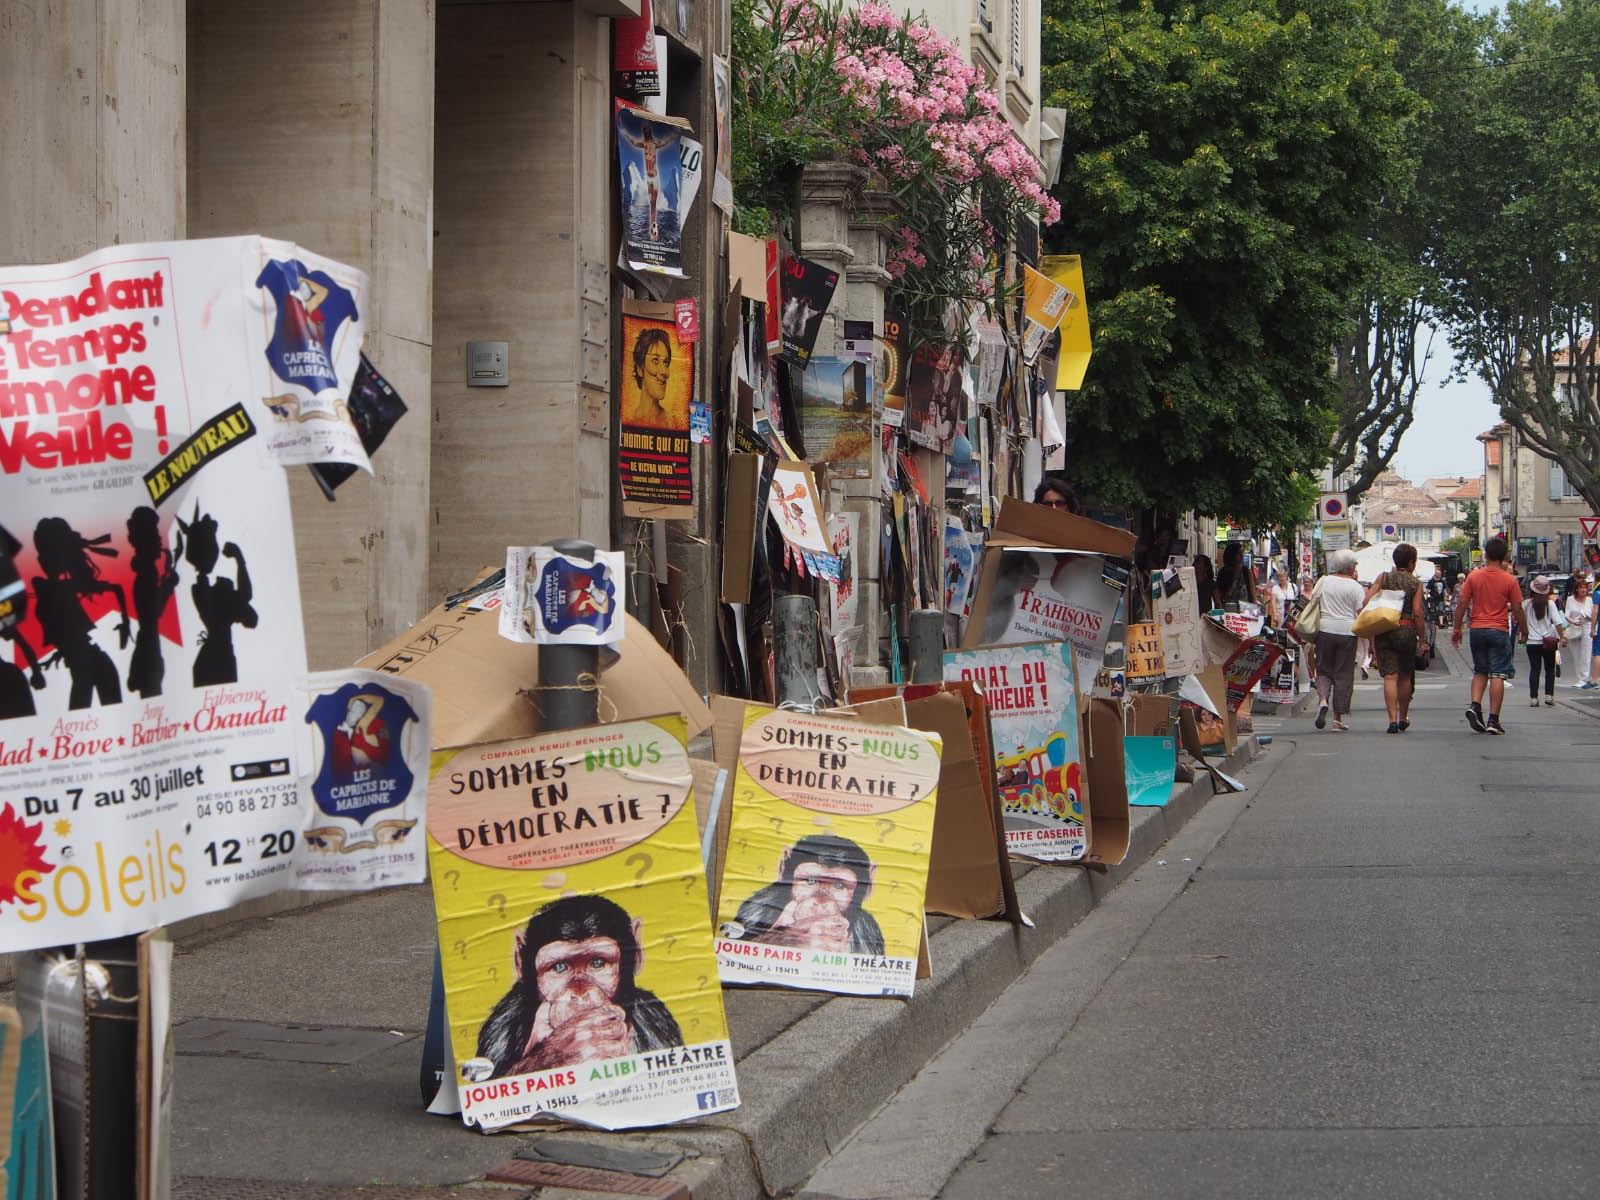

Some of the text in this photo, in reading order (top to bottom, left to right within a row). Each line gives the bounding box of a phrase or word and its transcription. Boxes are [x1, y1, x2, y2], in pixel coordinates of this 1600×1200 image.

[7, 321, 147, 370] Temps
[288, 364, 335, 379] MARIAN
[0, 364, 156, 419] imone
[147, 410, 249, 500] LE NOUVEAU
[656, 436, 672, 453] QUI
[674, 438, 689, 453] RIT
[1018, 587, 1103, 631] TRAHISONS
[1143, 626, 1156, 637] LE
[1022, 662, 1046, 685] DU
[983, 686, 1035, 711] NHEUR
[50, 713, 100, 739] Agnès
[53, 735, 113, 761] Bove
[131, 714, 182, 748] Barbier
[193, 699, 288, 733] Chaudat
[480, 746, 537, 761] COMPAGNIE
[761, 725, 920, 760] SOMMES-NOUS
[449, 740, 663, 795] SOMMES-NOUS
[819, 752, 848, 771] EN
[330, 778, 398, 800] CAPRICES DE
[353, 769, 371, 783] LES
[24, 795, 59, 818] Du
[64, 788, 84, 812] 7
[94, 789, 125, 809] au
[130, 775, 152, 802] 30
[153, 765, 205, 802] juillet
[335, 792, 391, 812] MARIANNE
[531, 781, 570, 811] EN
[197, 804, 212, 819] 04
[216, 800, 233, 815] 90
[239, 798, 256, 812] 88
[260, 794, 277, 810] 27
[281, 791, 298, 807] 33
[656, 793, 672, 819] ?
[1036, 827, 1083, 840] CASERNE
[204, 838, 243, 867] 12
[260, 829, 296, 860] 20
[14, 830, 187, 924] soleils
[715, 941, 913, 971] JOURS PAIRS ALIBI THÉÂTRE
[725, 960, 736, 968] 30
[465, 1081, 521, 1110] JOURS
[526, 1071, 577, 1093] PAIRS
[590, 1060, 637, 1082] ALIBI
[643, 1044, 726, 1071] THÉÂTRE
[546, 1095, 579, 1111] 15H15
